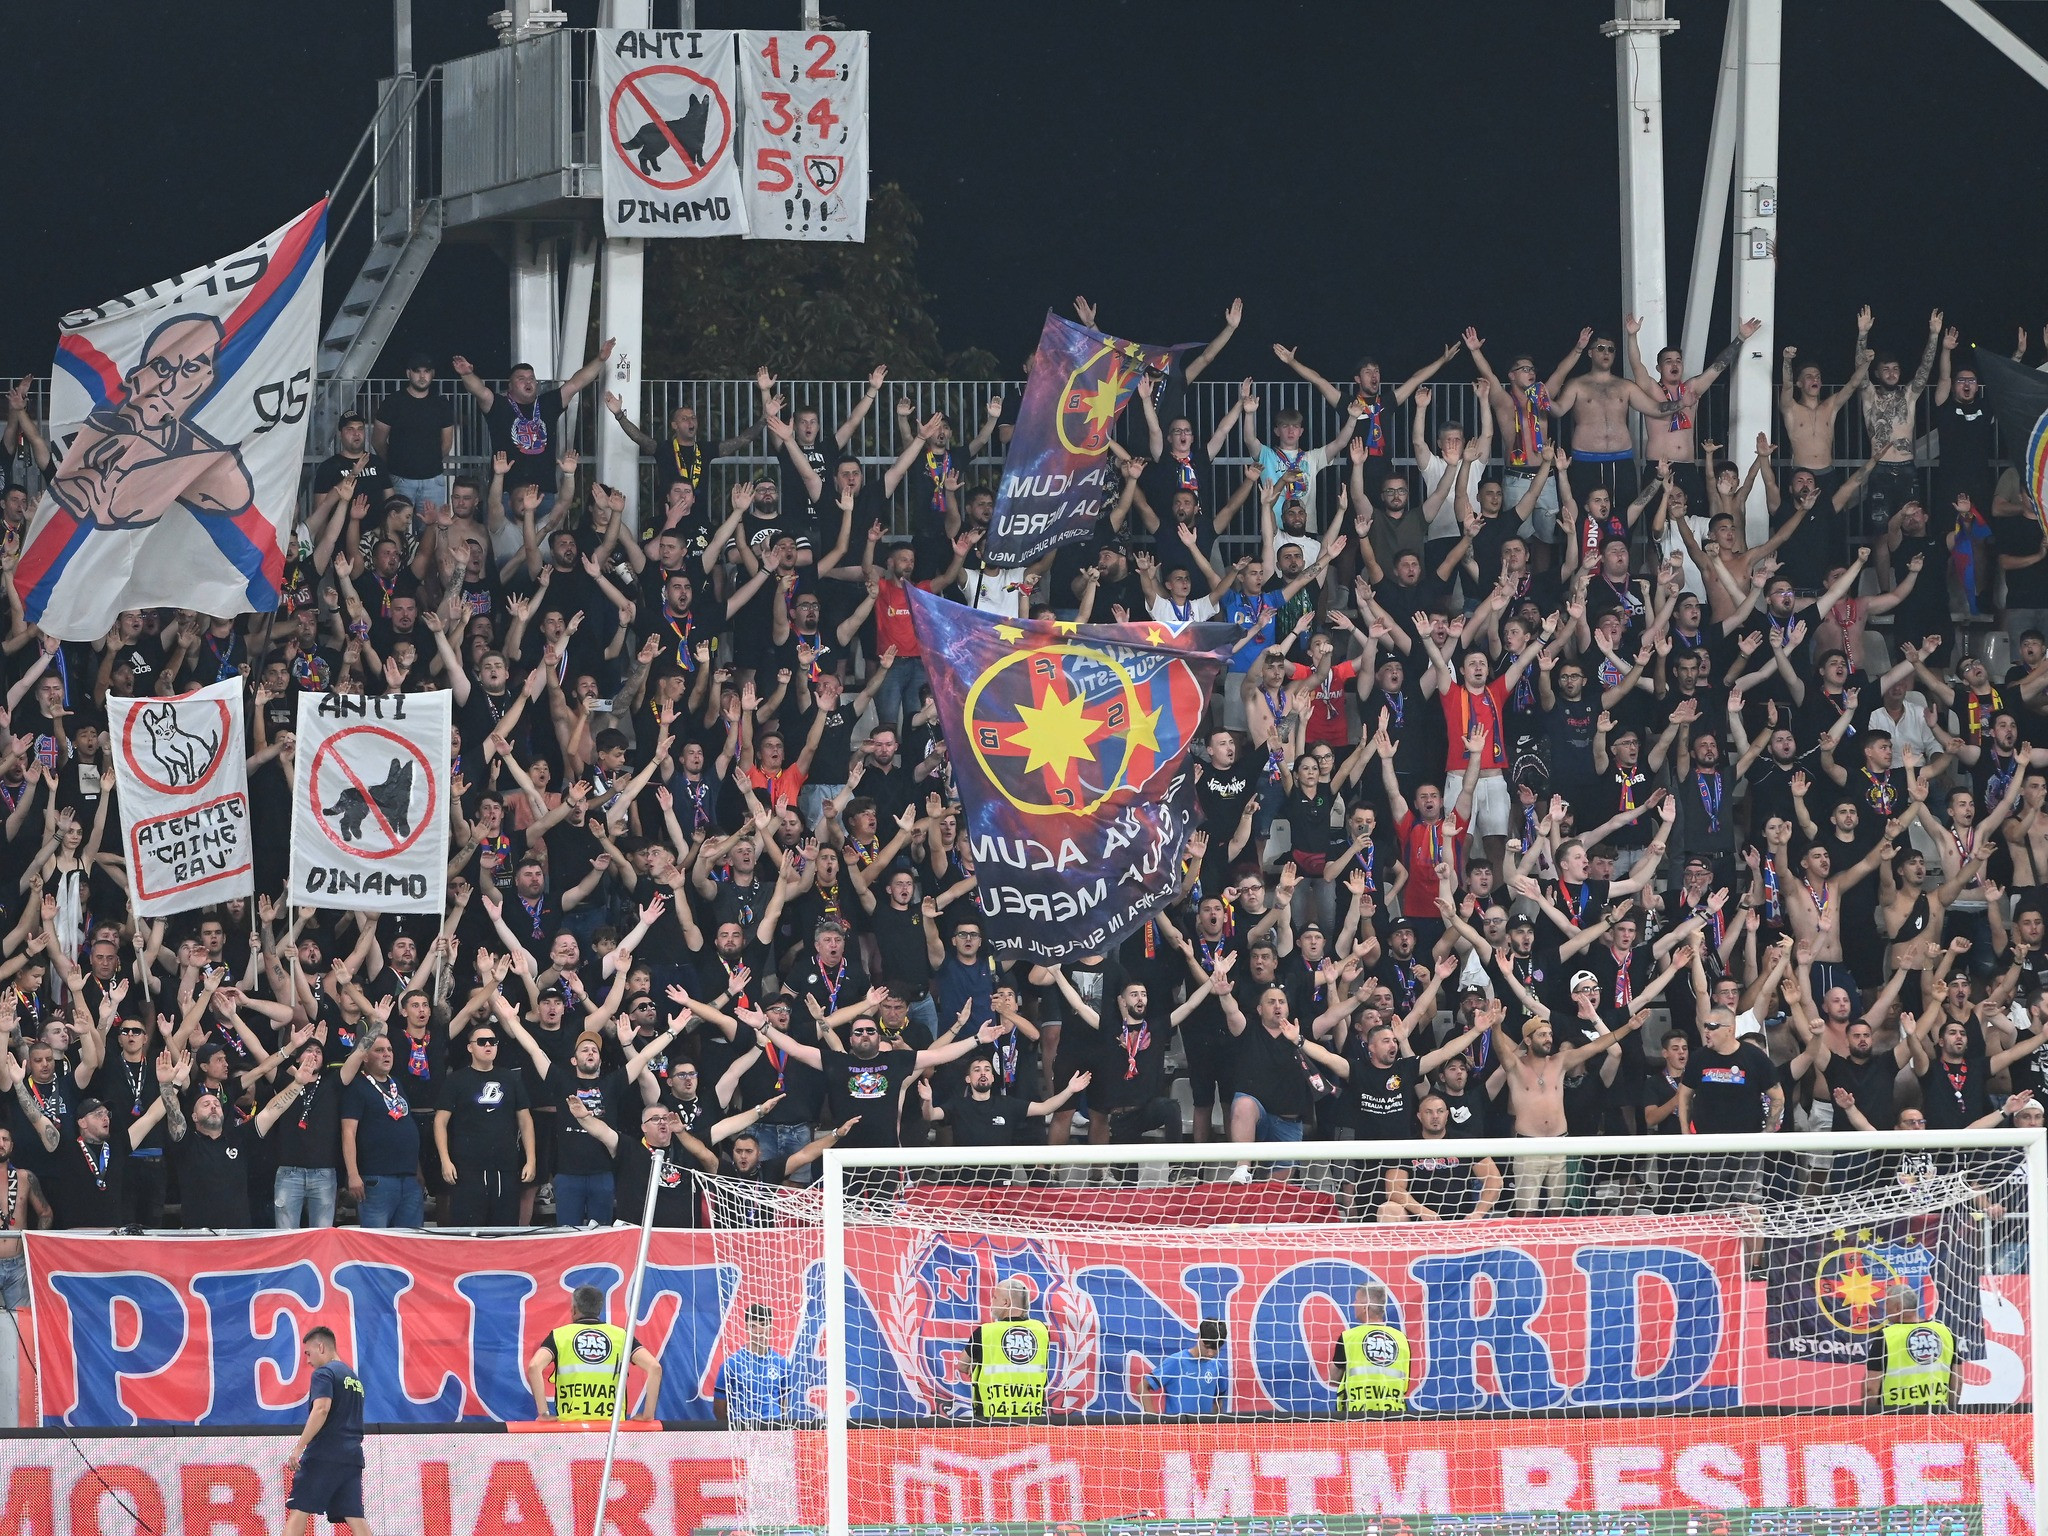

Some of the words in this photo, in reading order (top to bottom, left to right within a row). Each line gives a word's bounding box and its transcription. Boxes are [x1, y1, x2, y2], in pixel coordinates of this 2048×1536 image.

[615, 31, 704, 59] ANTI
[618, 197, 731, 224] DINAMO
[318, 692, 406, 721] ANTI
[305, 866, 428, 900] DINAMO
[47, 1259, 933, 1427] PELUZA
[1071, 1245, 1724, 1416] NORD
[1162, 1449, 1452, 1516] MTM
